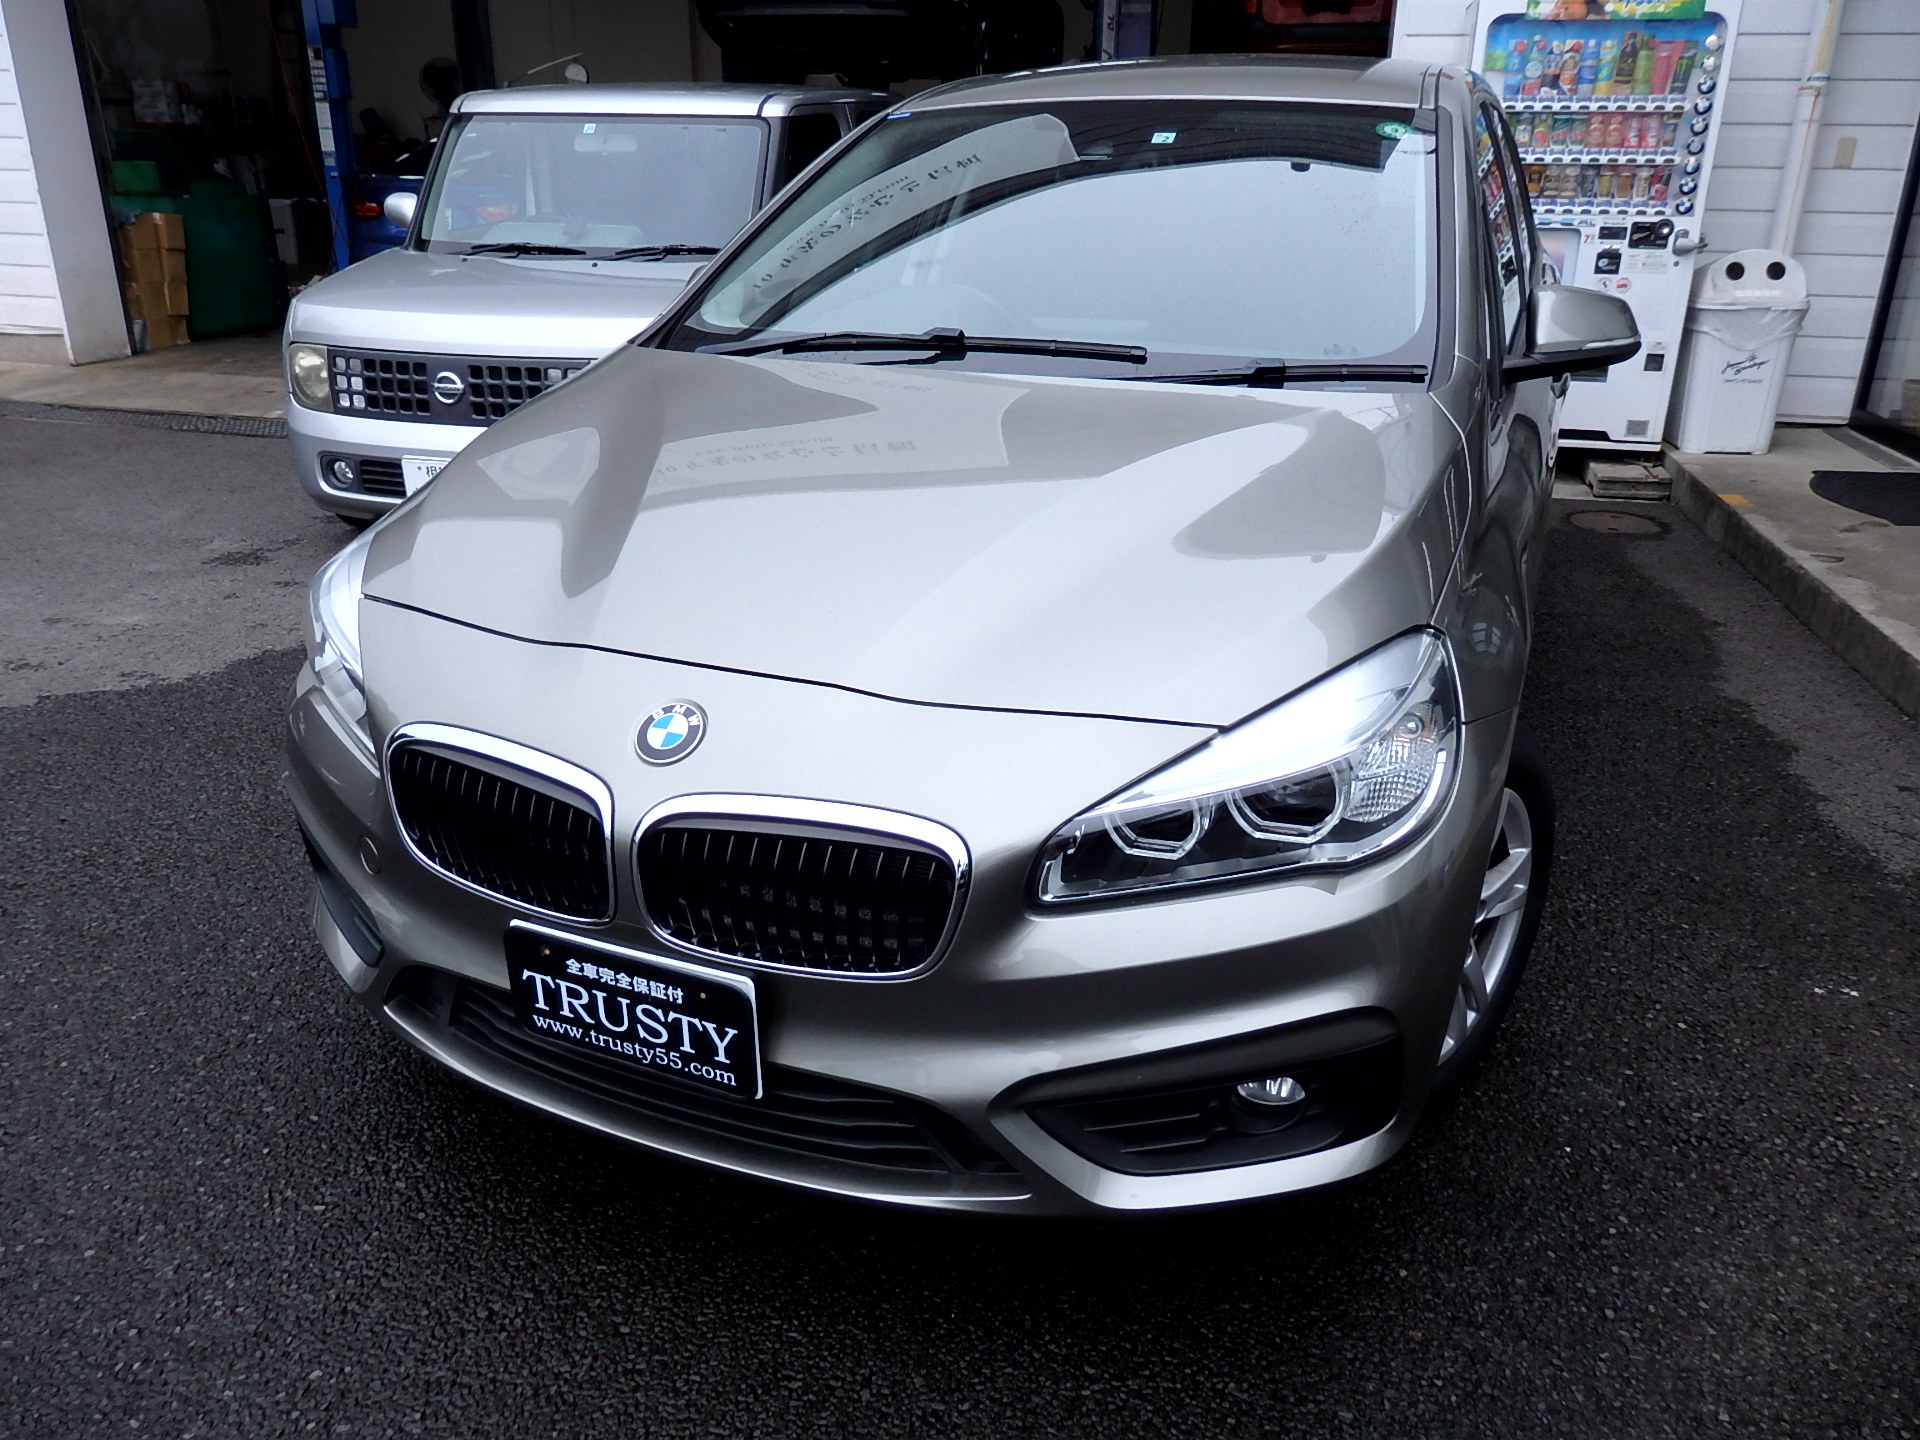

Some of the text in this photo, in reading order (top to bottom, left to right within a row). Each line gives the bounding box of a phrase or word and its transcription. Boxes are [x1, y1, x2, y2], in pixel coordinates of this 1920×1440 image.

[653, 705, 701, 726] BMW
[566, 958, 684, 1004] 全車完全保証付
[523, 969, 738, 1064] TRUSTY
[533, 1015, 737, 1086] www.trusty55.com
